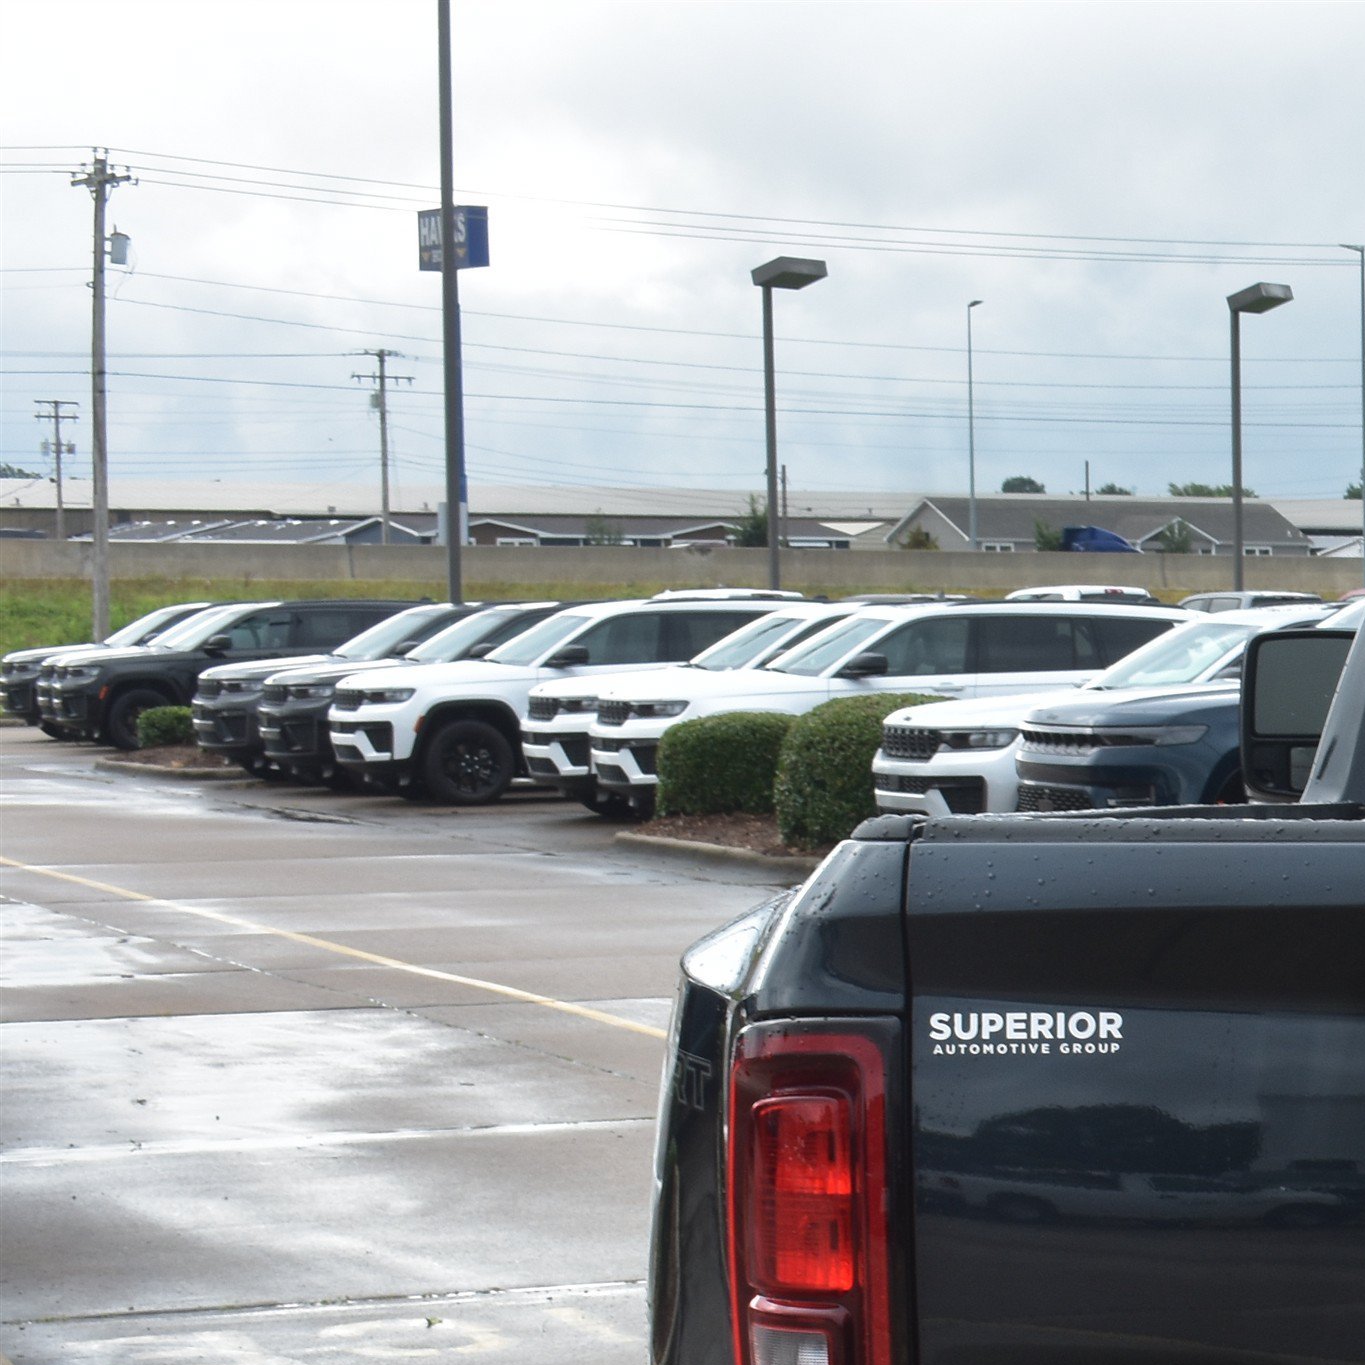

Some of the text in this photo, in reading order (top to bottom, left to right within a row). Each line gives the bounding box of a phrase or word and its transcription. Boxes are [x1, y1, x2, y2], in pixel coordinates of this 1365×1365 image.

[929, 1011, 1123, 1041] SUPERIOR
[933, 1043, 1121, 1055] AUTOMOTIVE GROUP
